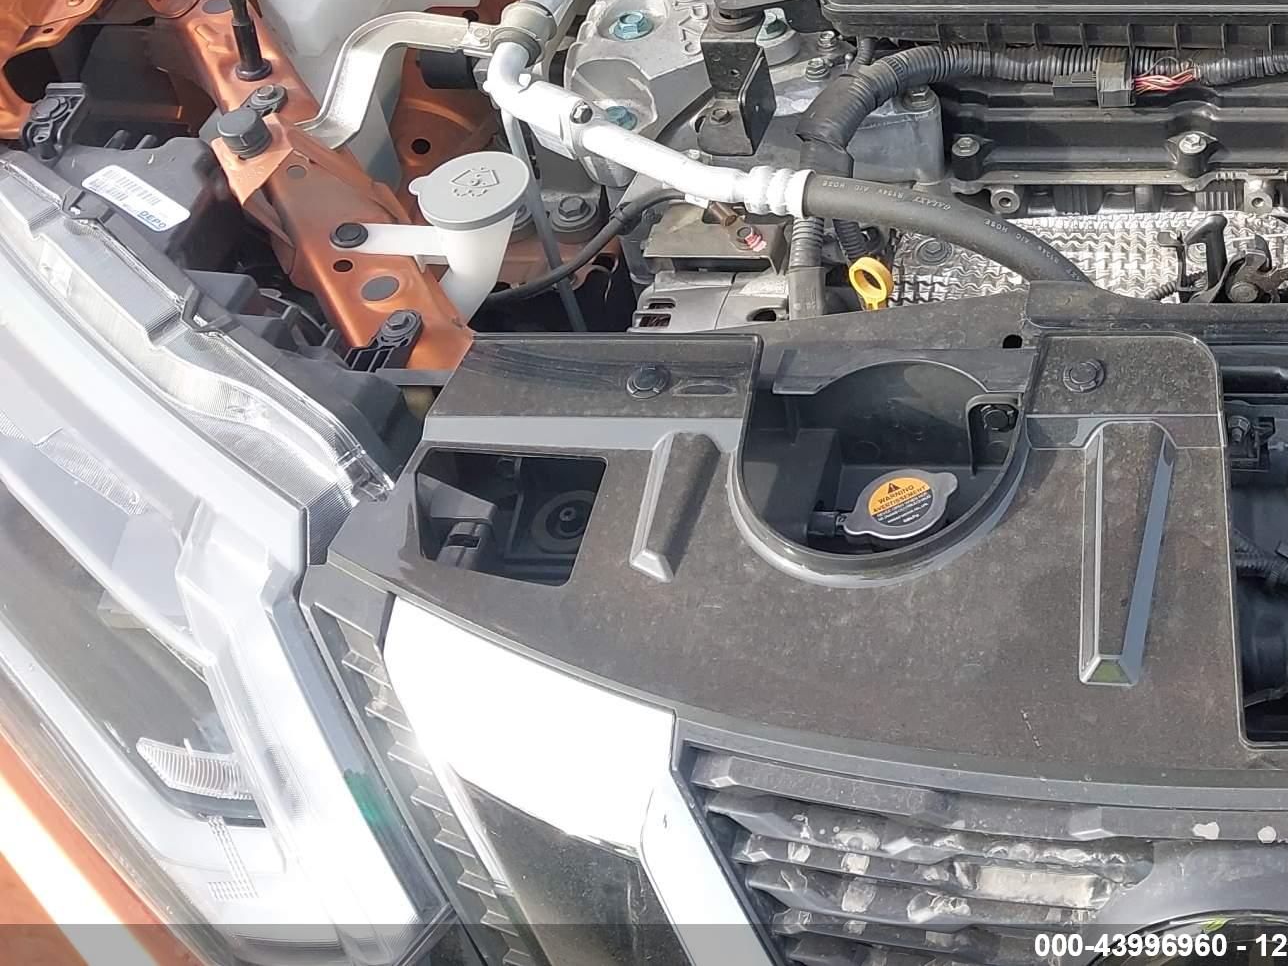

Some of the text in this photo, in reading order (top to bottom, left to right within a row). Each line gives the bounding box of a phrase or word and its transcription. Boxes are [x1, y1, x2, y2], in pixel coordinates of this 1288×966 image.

[822, 180, 845, 188] HOSE
[912, 196, 951, 211] GALAXY
[139, 210, 168, 229] DEPO
[984, 218, 1009, 233] HOSE
[872, 485, 926, 512] AVERTISSEMENT
[877, 484, 914, 503] WARNING
